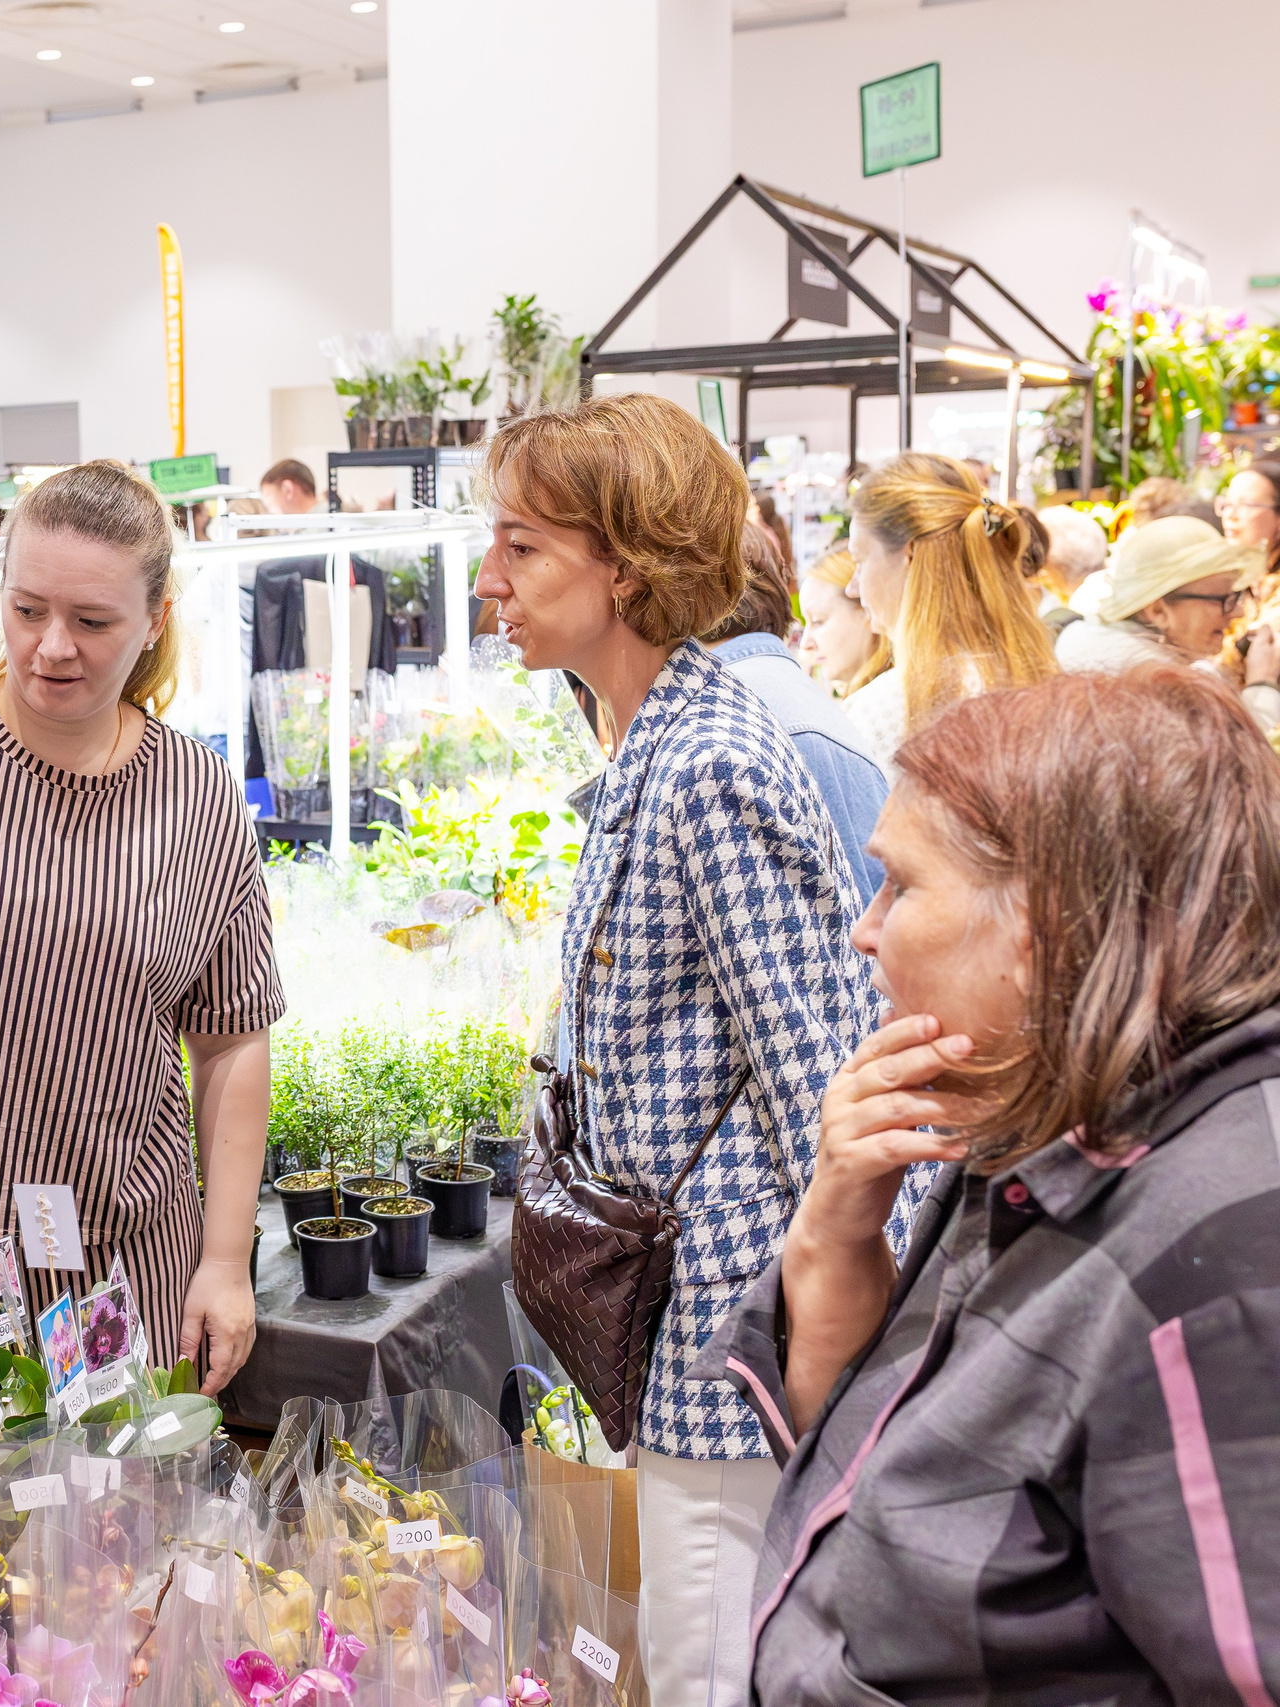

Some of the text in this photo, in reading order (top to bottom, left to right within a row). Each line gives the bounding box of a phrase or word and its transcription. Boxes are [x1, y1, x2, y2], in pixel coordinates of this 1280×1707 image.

[95, 1378, 118, 1397] 1500
[68, 1392, 86, 1414] 1500
[233, 1478, 247, 1499] 220
[353, 1486, 383, 1511] 2200
[396, 1529, 433, 1546] 2200
[580, 1640, 613, 1671] 2200
